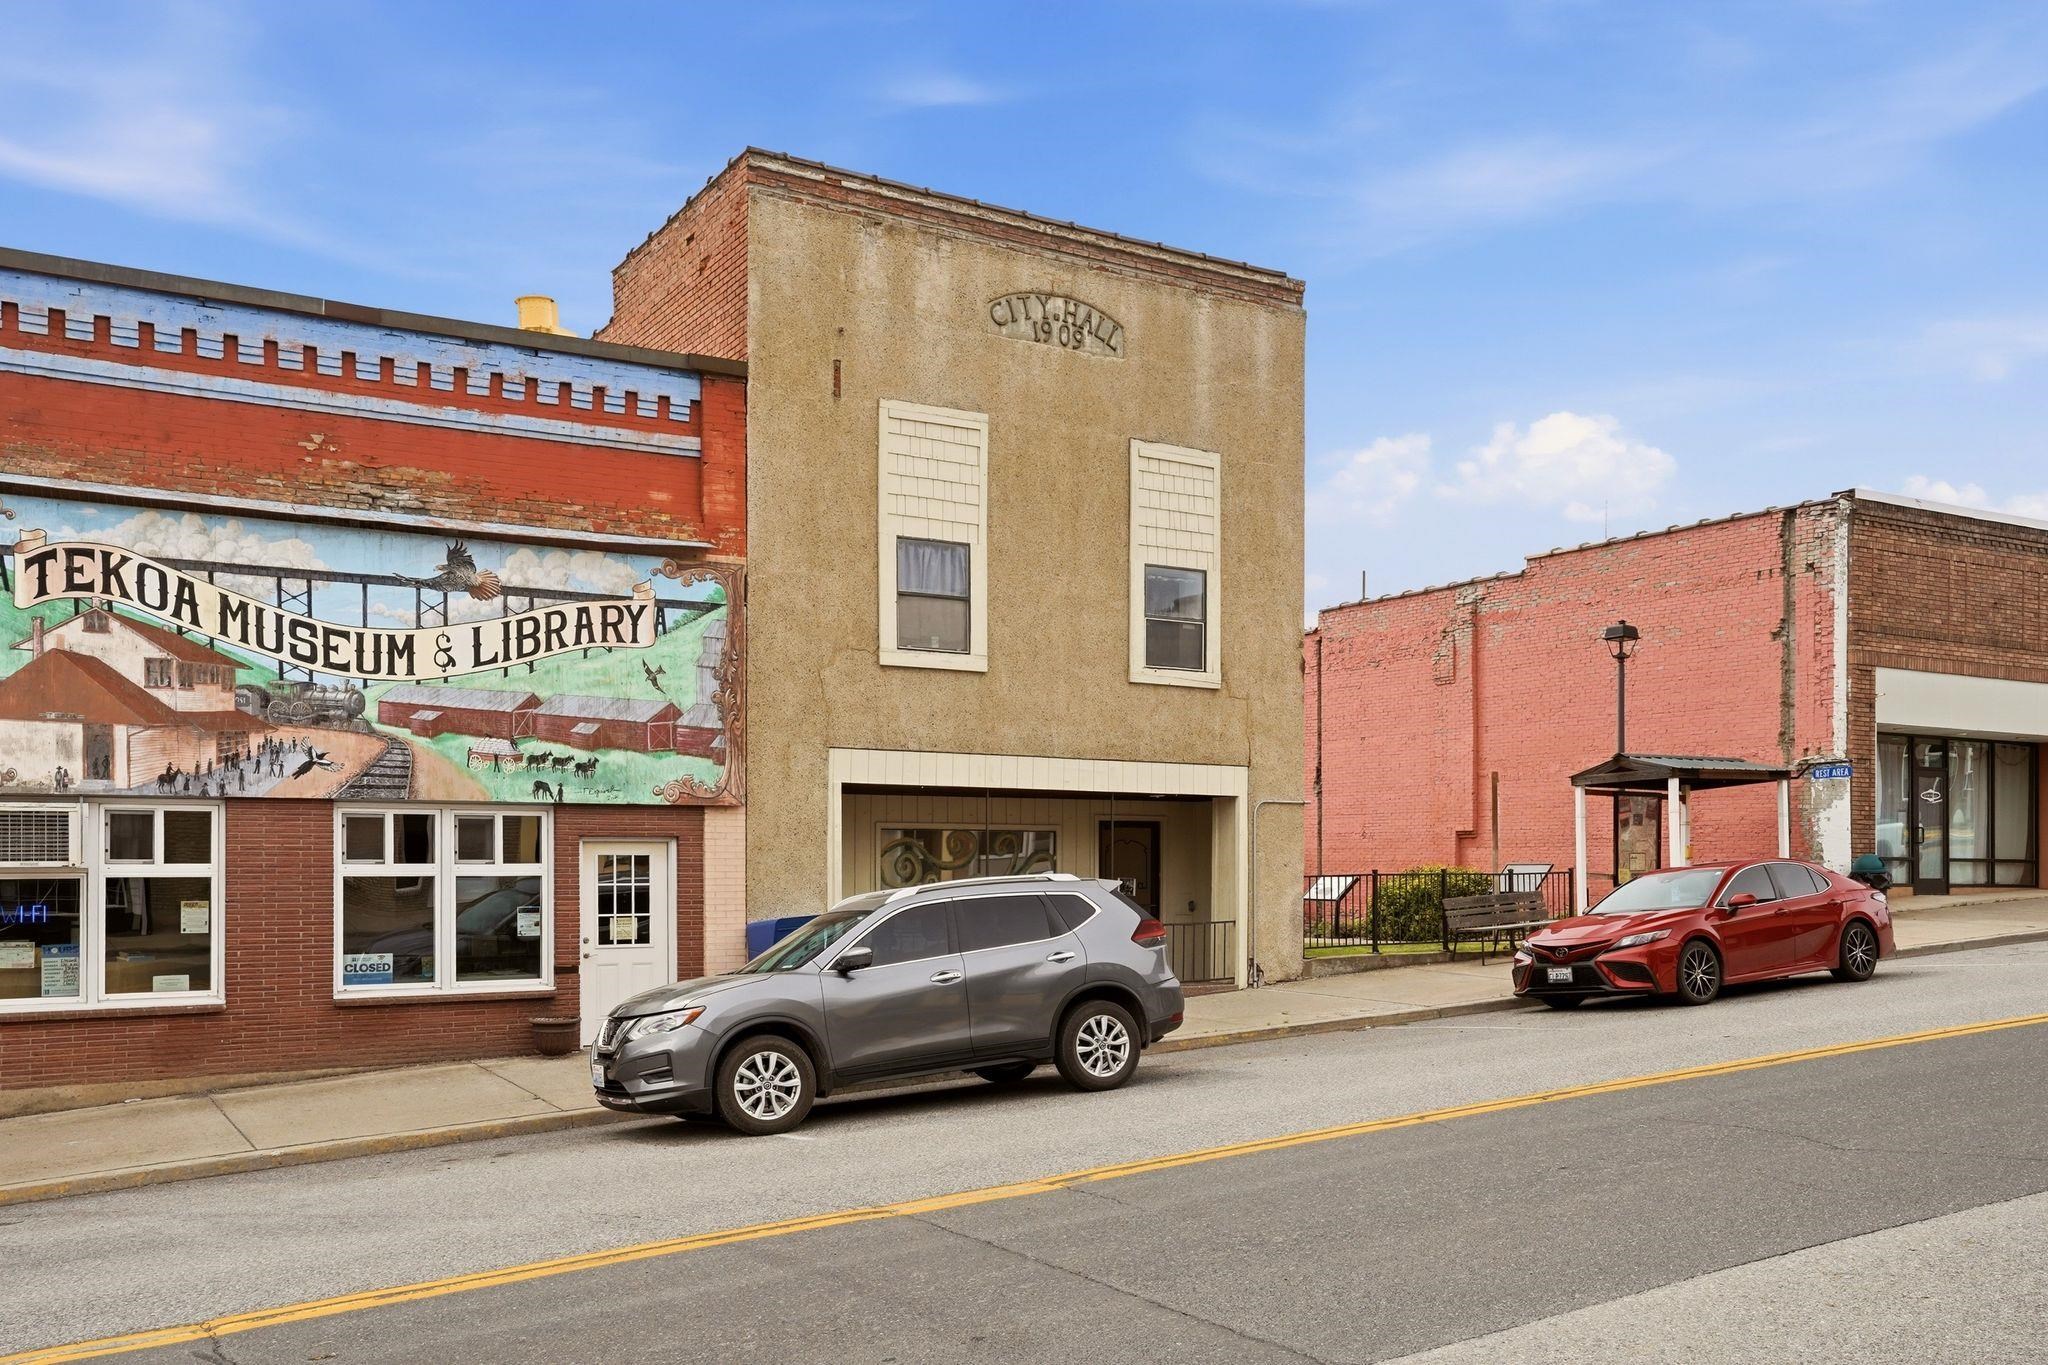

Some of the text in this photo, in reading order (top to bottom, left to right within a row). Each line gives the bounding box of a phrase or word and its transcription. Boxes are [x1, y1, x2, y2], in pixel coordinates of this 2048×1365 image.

[1033, 320, 1084, 350] 1909
[24, 547, 648, 677] TEKOA MUSEUM & LIBRARY
[1815, 767, 1849, 778] REST AREA
[0, 904, 47, 923] WI-FI
[344, 963, 391, 973] CLOSED
